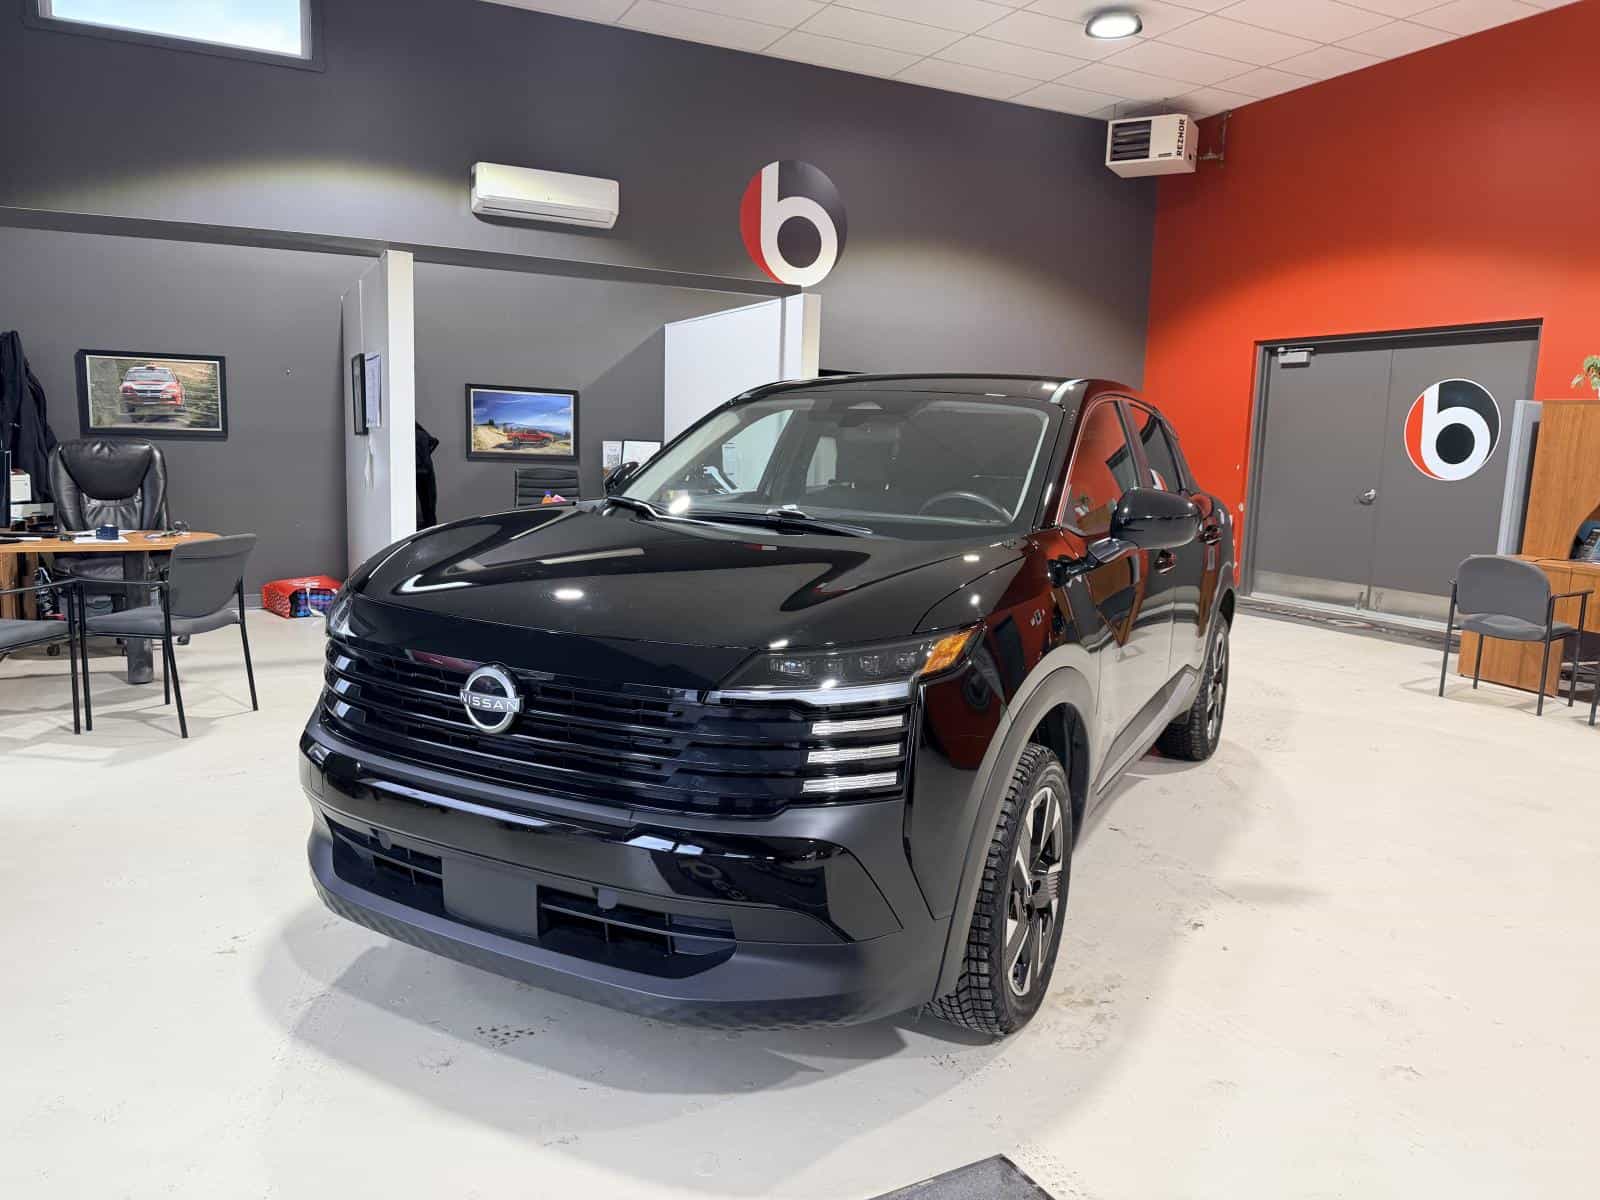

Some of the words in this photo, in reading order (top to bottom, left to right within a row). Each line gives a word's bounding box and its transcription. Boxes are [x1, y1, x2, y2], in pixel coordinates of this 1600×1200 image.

[1176, 119, 1185, 156] REZNOR
[760, 160, 838, 288] b
[1420, 382, 1491, 480] b
[460, 691, 519, 712] NISSAN
